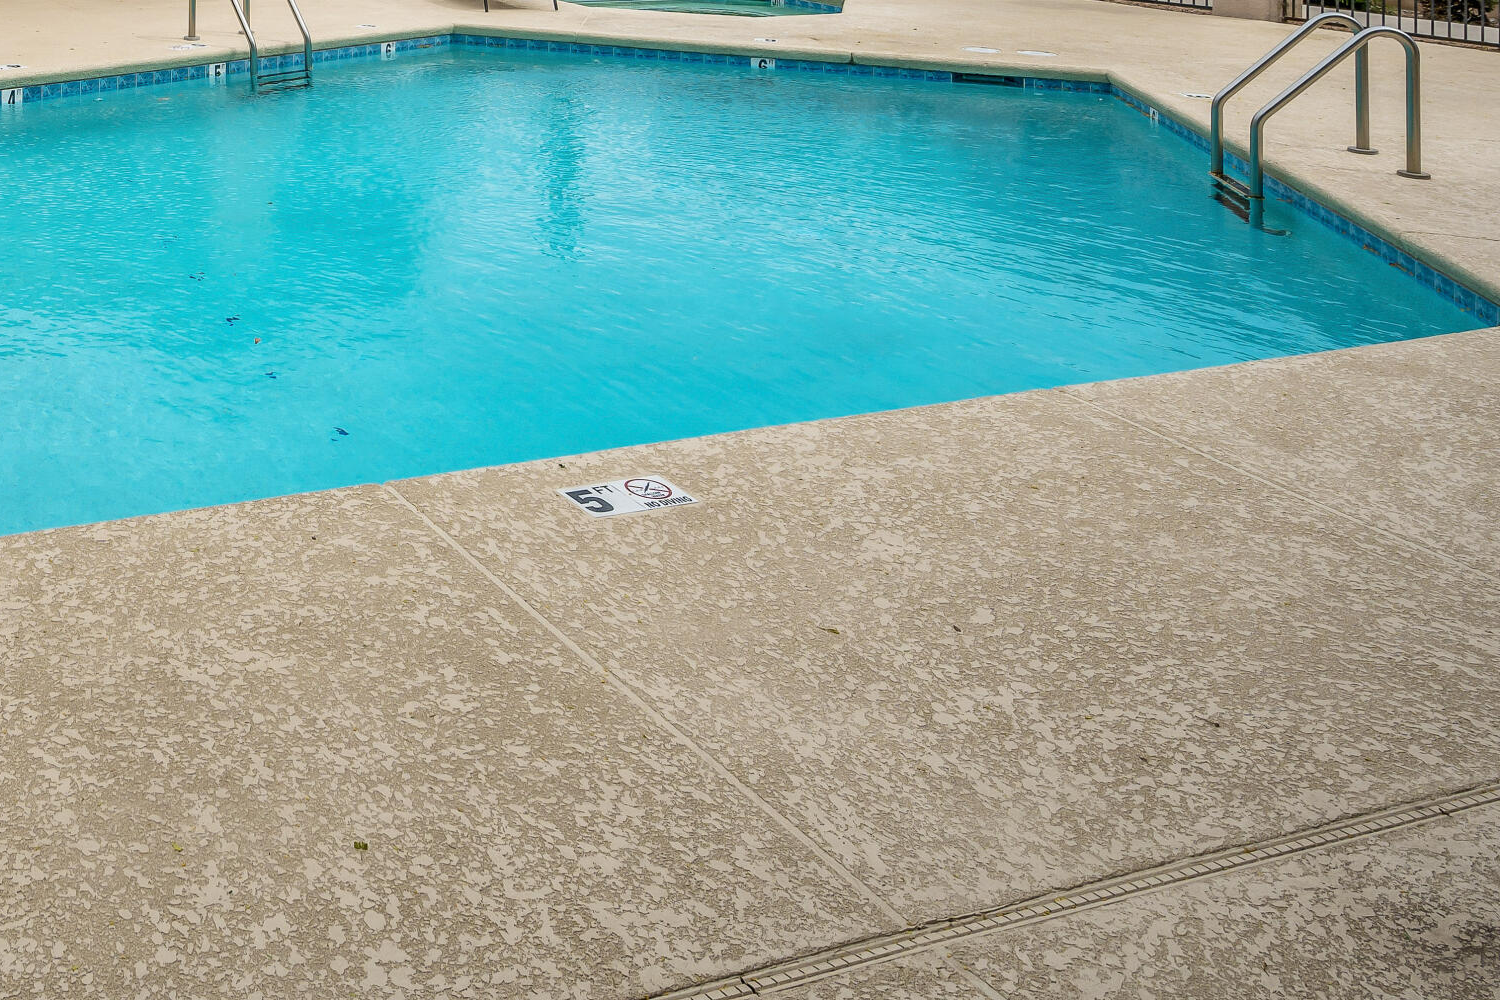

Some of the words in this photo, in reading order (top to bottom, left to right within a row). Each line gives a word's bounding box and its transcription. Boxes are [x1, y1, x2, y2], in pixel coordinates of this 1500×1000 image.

[565, 489, 614, 513] 5
[592, 485, 613, 495] FT
[659, 496, 693, 506] DIVING
